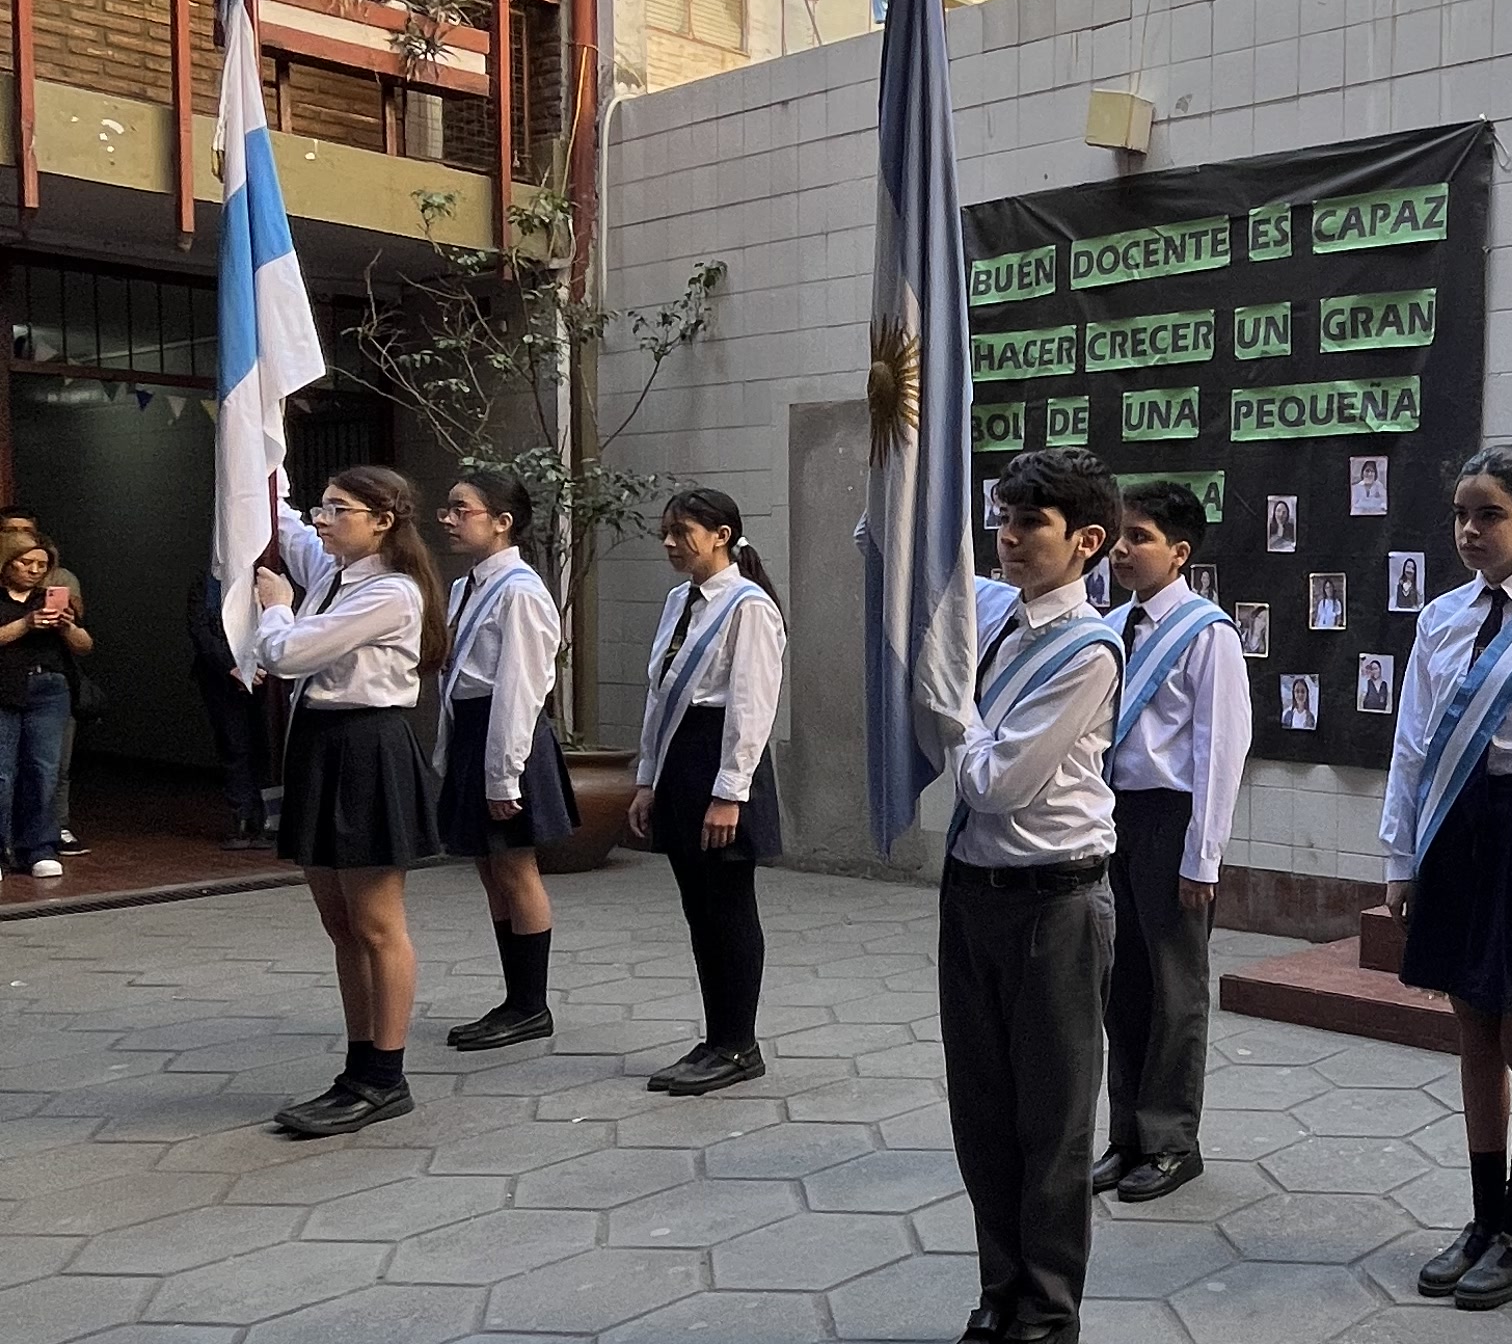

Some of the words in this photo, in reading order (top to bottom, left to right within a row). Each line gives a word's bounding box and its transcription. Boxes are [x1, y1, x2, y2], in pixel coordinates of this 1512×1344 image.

[972, 258, 1054, 296] BUEN
[1072, 227, 1229, 279] DOCENTE
[1251, 215, 1290, 251] ES
[1313, 195, 1446, 243] CAPAZ
[974, 336, 1076, 372] HACER
[1087, 321, 1213, 362] CRECER
[1237, 314, 1289, 349] UN
[1322, 301, 1433, 341] GRAN
[1050, 406, 1088, 436] DE
[1124, 398, 1198, 432] UNA
[1233, 381, 1418, 431] PEQUEÑA
